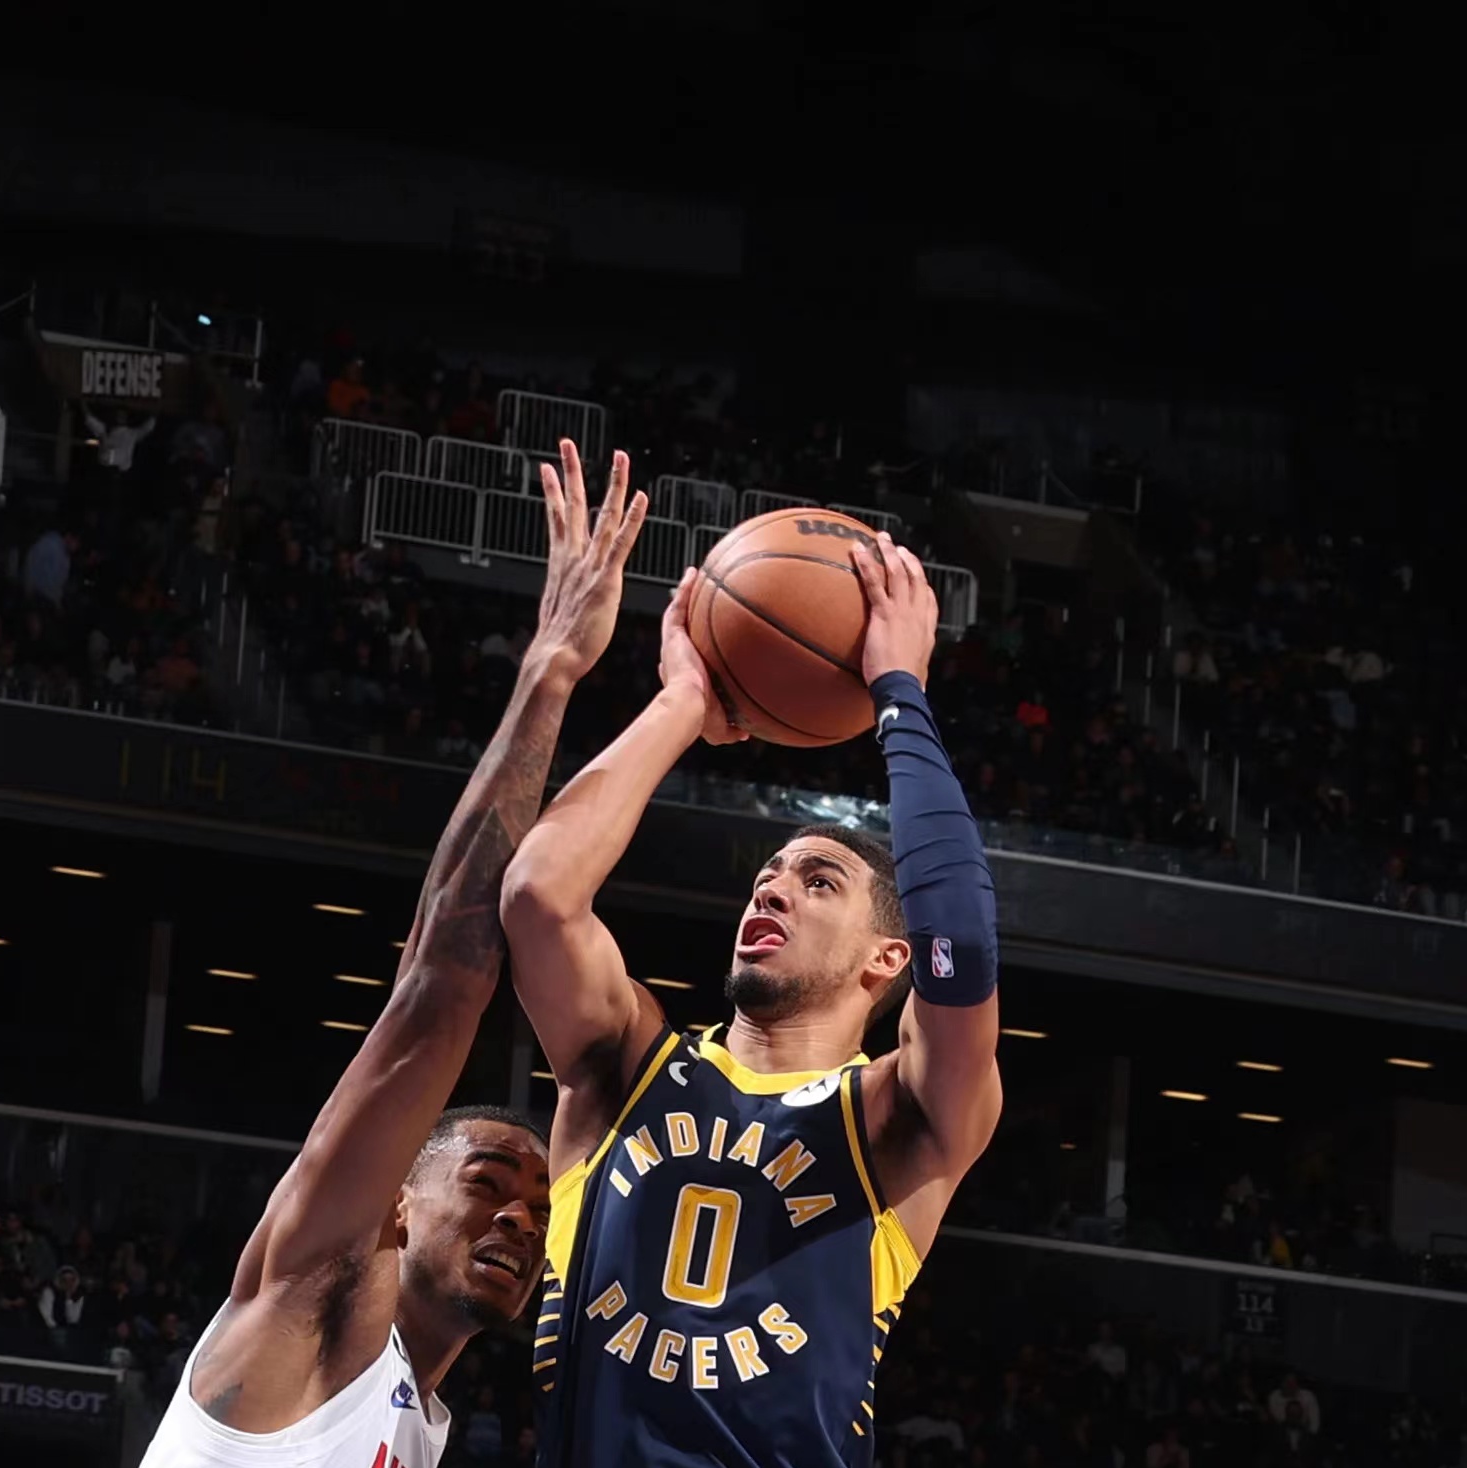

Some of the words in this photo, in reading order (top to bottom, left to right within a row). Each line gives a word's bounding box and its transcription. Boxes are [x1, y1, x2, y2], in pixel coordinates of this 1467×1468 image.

[81, 351, 162, 399] DEFENSE
[609, 1111, 837, 1229] INDIANA
[661, 1182, 742, 1309] 0
[584, 1280, 808, 1390] PACERS
